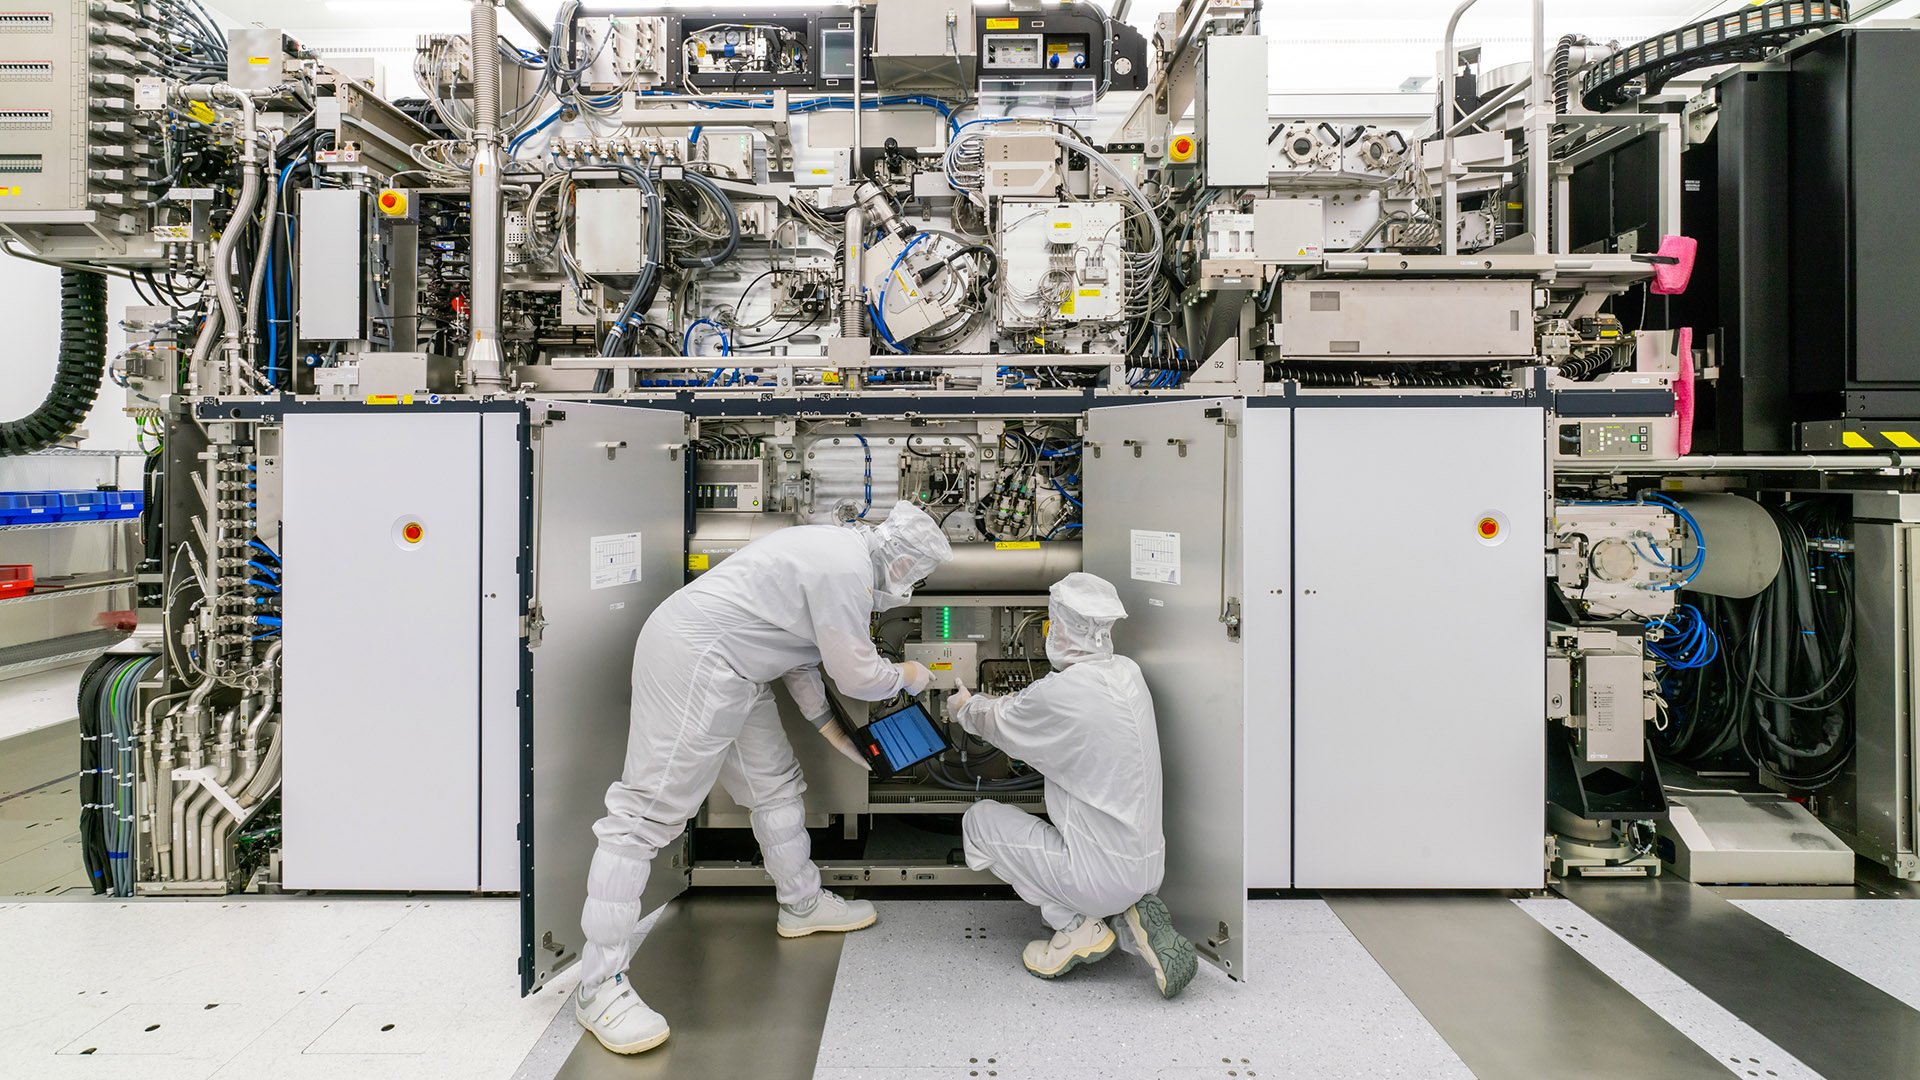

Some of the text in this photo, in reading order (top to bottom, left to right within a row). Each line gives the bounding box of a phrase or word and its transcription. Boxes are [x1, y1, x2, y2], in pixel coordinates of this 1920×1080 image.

[1214, 361, 1224, 369] 52
[762, 393, 773, 401] 53
[820, 393, 831, 401] 53
[1528, 390, 1537, 399] 51
[204, 397, 214, 405] 55
[483, 395, 494, 404] 54
[264, 458, 274, 466] 56
